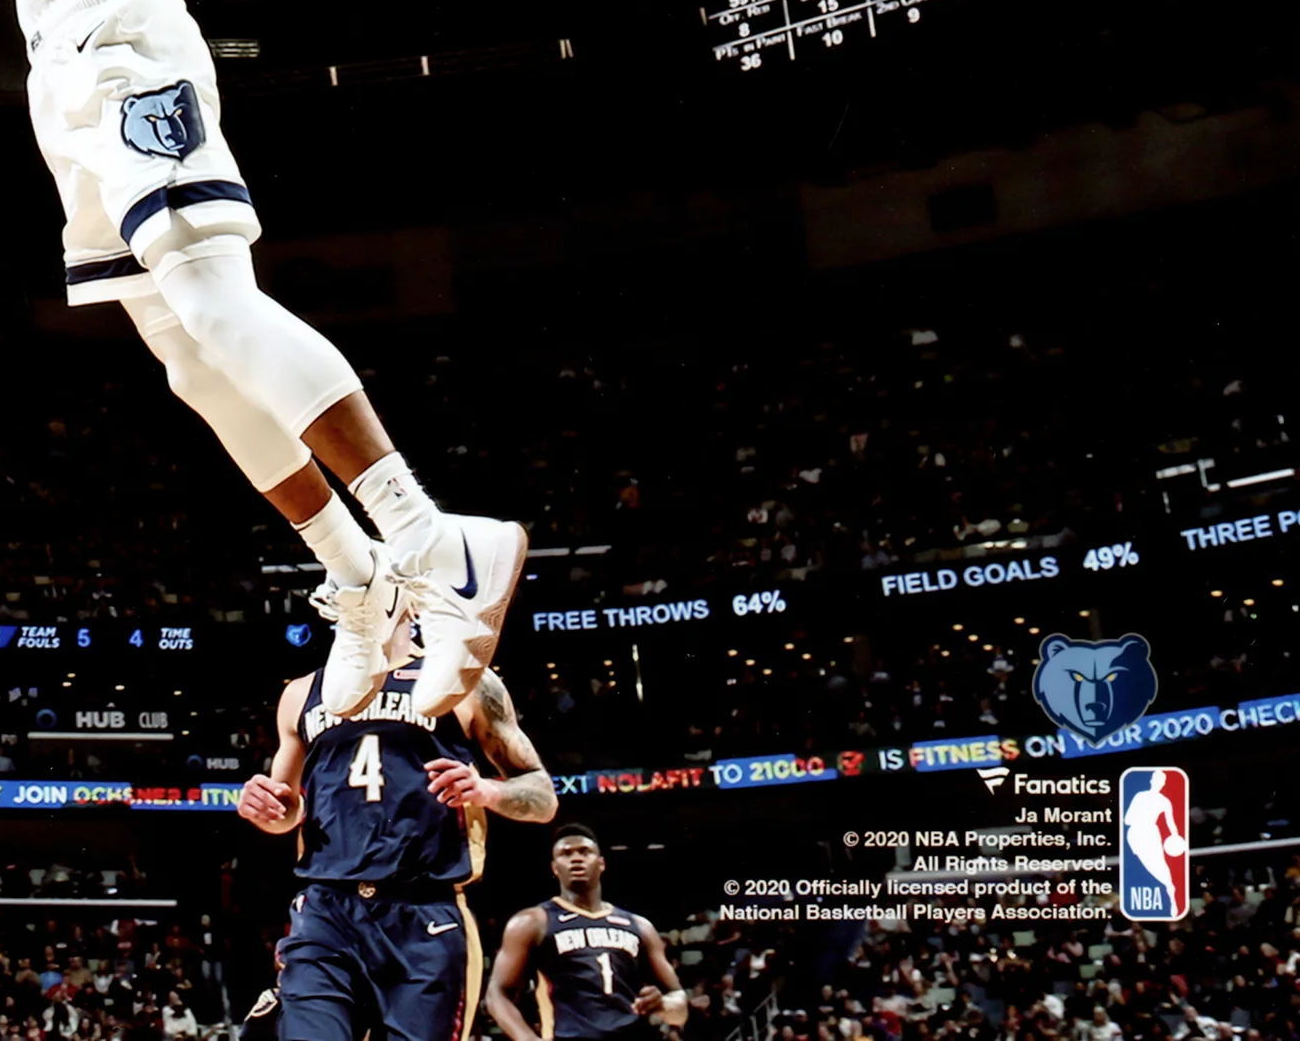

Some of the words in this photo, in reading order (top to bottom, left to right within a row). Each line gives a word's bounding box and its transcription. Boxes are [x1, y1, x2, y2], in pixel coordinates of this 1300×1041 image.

[907, 7, 921, 23] 9
[738, 22, 751, 37] 8
[821, 29, 844, 47] 10
[740, 52, 762, 71] 36
[1180, 515, 1273, 551] THREE
[881, 568, 958, 597] FIELD
[963, 556, 1060, 588] GOALS
[1082, 541, 1139, 572] 49%
[533, 610, 598, 632] FREE
[602, 599, 710, 628] THROWS
[732, 589, 786, 616] 64%
[22, 626, 56, 637] TEAM
[77, 629, 91, 647] 5
[128, 629, 143, 647] 4
[160, 628, 191, 639] TIME
[17, 637, 60, 649] FOULS
[158, 639, 193, 650] OUTS
[76, 711, 126, 729] HUB
[139, 711, 168, 729] CLUB
[879, 748, 903, 770] IS
[909, 739, 1020, 767] FITNESS
[1025, 733, 1067, 757] ON
[1069, 725, 1142, 752] YUR
[1147, 713, 1214, 743] 2020
[206, 757, 240, 770] HUB
[348, 734, 385, 802] 4
[551, 775, 590, 794] EXT
[709, 764, 742, 786] TO
[13, 785, 67, 804] JOIN
[187, 787, 242, 806] FITN
[595, 952, 613, 995] 1
